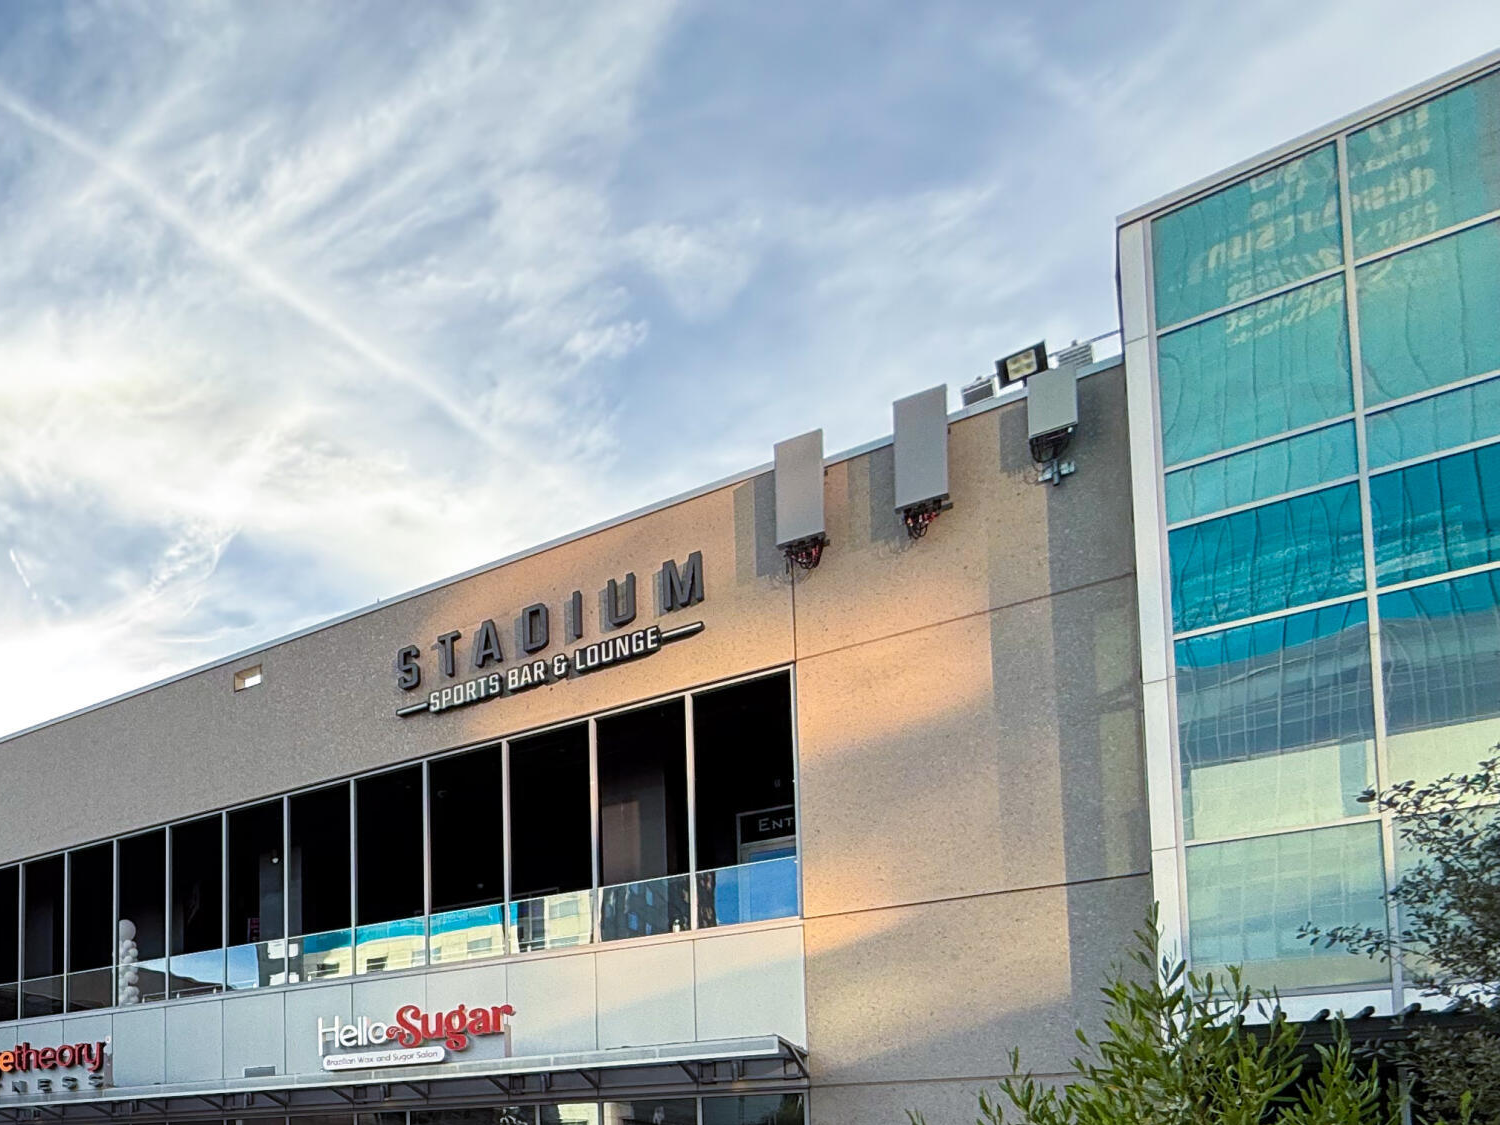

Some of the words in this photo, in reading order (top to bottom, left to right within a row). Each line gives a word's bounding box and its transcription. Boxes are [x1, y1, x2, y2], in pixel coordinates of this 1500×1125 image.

[397, 550, 705, 690] STADIUM
[429, 672, 500, 713] SPORTS
[507, 659, 546, 690] BAR
[553, 653, 569, 676] &
[575, 625, 660, 672] LOUNGE
[317, 1015, 387, 1057] Hello
[386, 1004, 515, 1051] Sugar
[326, 1058, 357, 1067] Brazilian
[358, 1056, 374, 1064] Wax
[377, 1054, 391, 1062] and
[392, 1052, 415, 1062] Sugar
[416, 1051, 438, 1059] Salon
